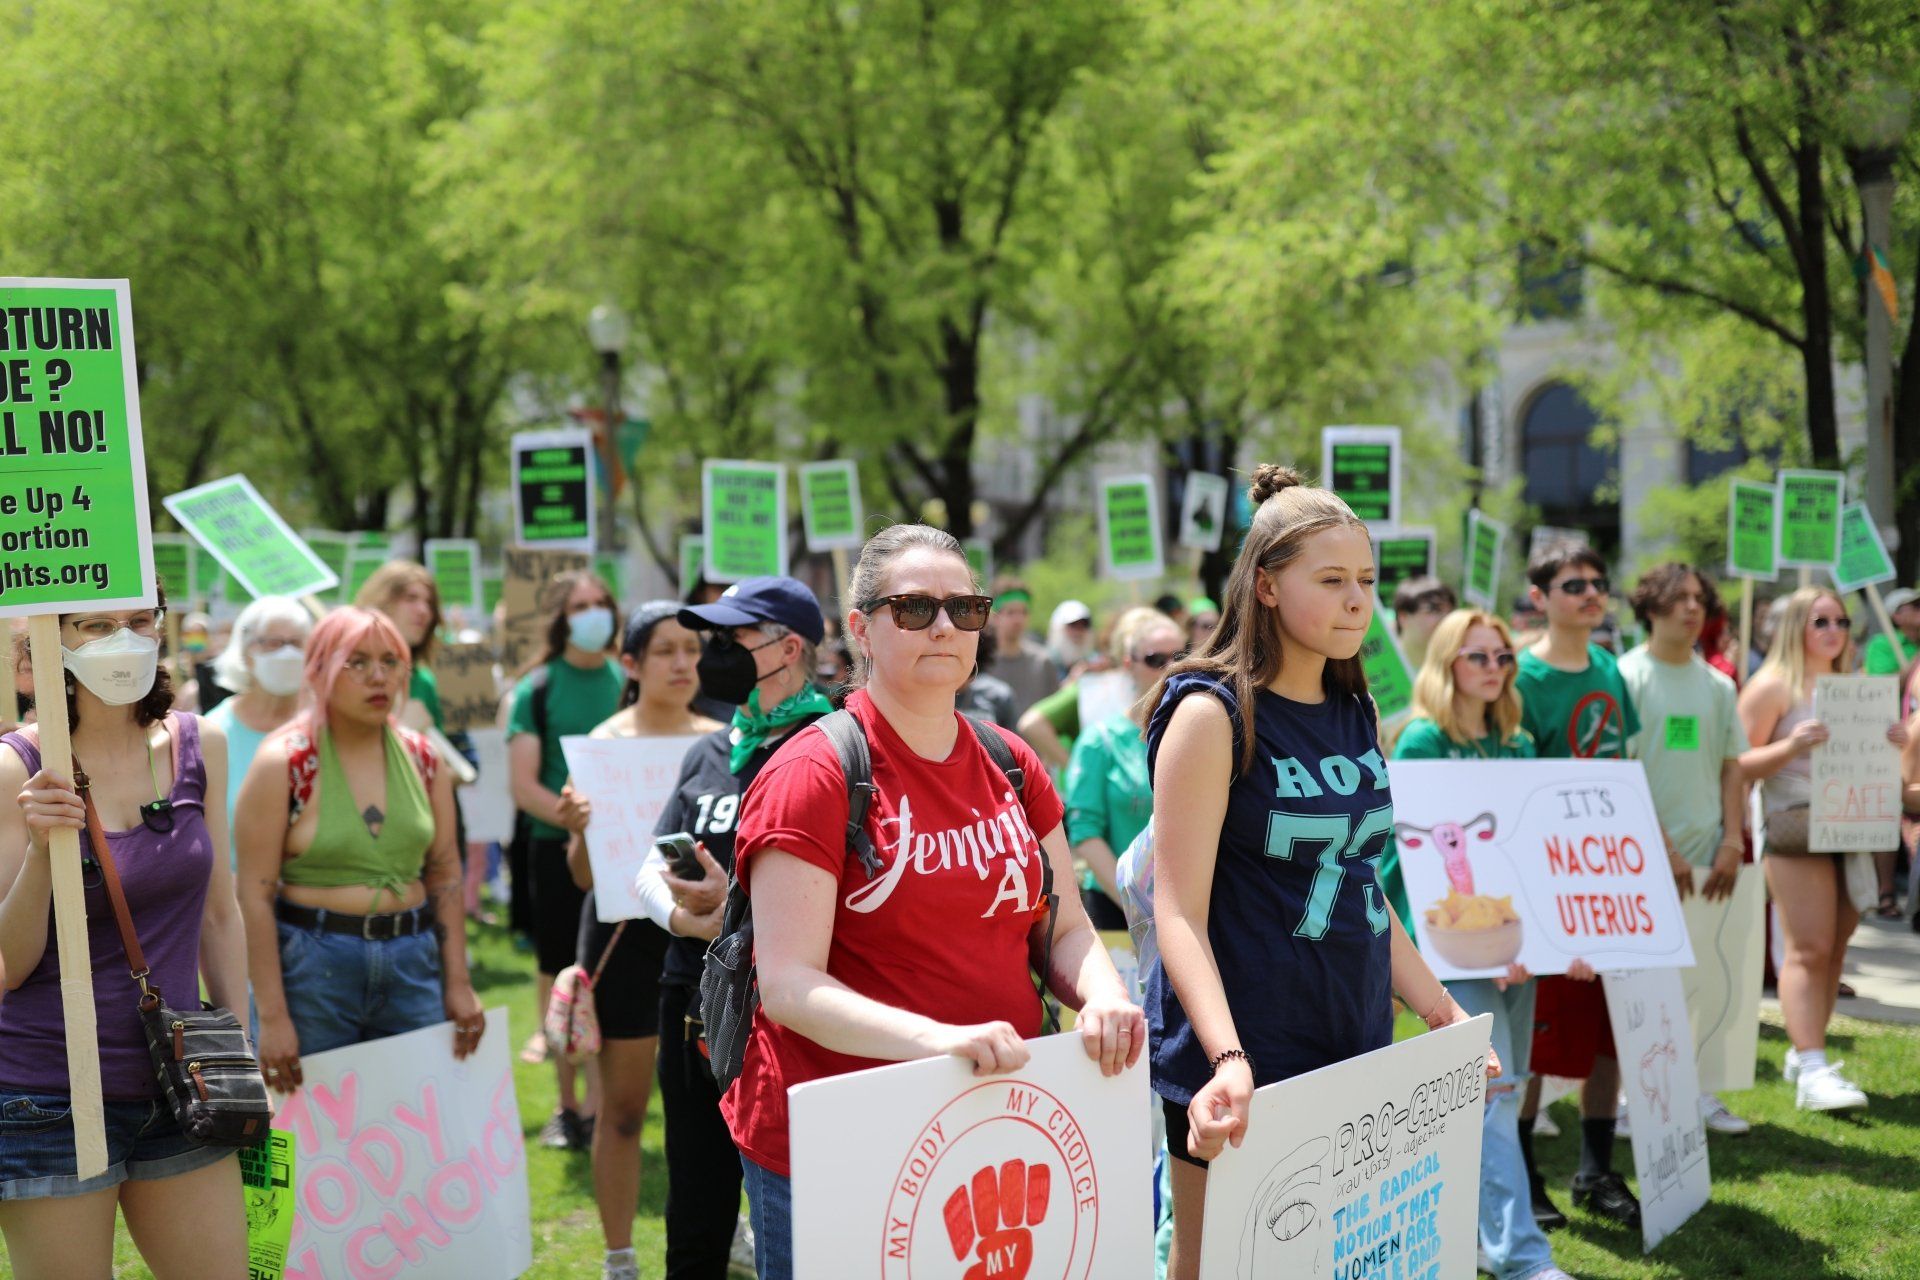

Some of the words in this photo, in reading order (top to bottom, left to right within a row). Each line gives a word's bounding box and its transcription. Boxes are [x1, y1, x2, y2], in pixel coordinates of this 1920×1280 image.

[45, 358, 73, 402] ?
[0, 412, 28, 455] L
[39, 410, 106, 455] NO!
[26, 487, 63, 519] Up
[72, 486, 91, 511] 4
[0, 562, 109, 596] hts.org
[112, 670, 131, 679] 3M
[695, 793, 743, 834] 19
[1556, 786, 1616, 820] IT'S
[1823, 778, 1895, 820] SAFE
[1544, 833, 1645, 877] NACHO
[1556, 892, 1655, 937] UTERUS
[1332, 1055, 1484, 1177] PRO-CHOICE
[1403, 1121, 1446, 1155] adjective
[900, 1121, 945, 1197] BODY
[1006, 1088, 1039, 1115] MY
[1048, 1110, 1096, 1213] CHOICE
[1332, 1193, 1370, 1235] THE
[1379, 1151, 1441, 1207] RADICAL
[1333, 1211, 1392, 1263] NOTION
[1396, 1181, 1444, 1226] THAT
[986, 1243, 1017, 1276] MY
[1333, 1229, 1401, 1280] WOMEN
[1405, 1210, 1438, 1253] ARE
[1407, 1234, 1442, 1278] AND
